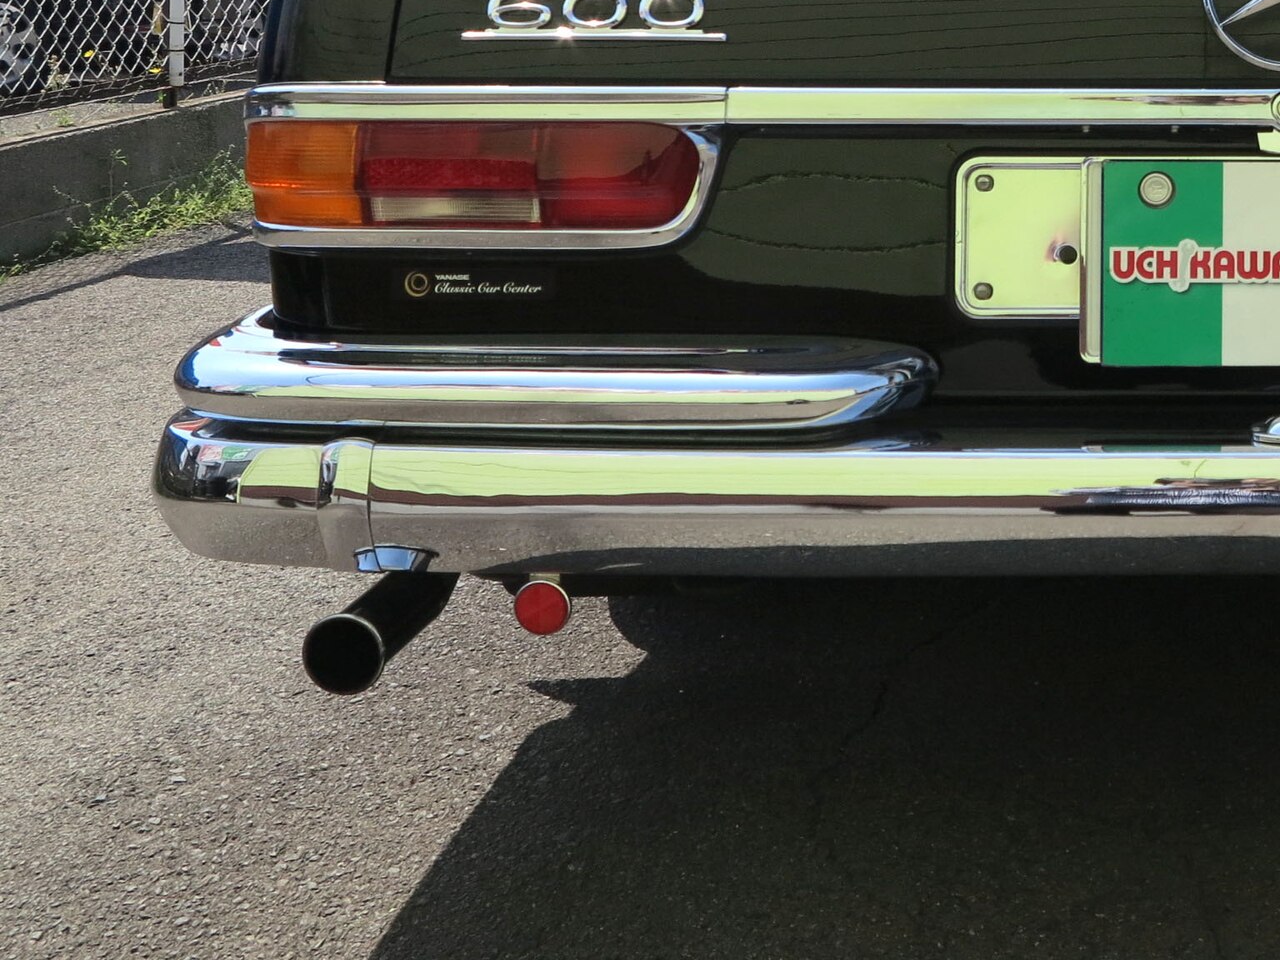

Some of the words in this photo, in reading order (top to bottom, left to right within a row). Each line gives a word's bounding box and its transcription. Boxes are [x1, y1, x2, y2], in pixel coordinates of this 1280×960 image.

[434, 273, 470, 281] YANASE
[434, 282, 476, 294] Classic
[478, 282, 501, 294] Car
[503, 282, 542, 294] Center
